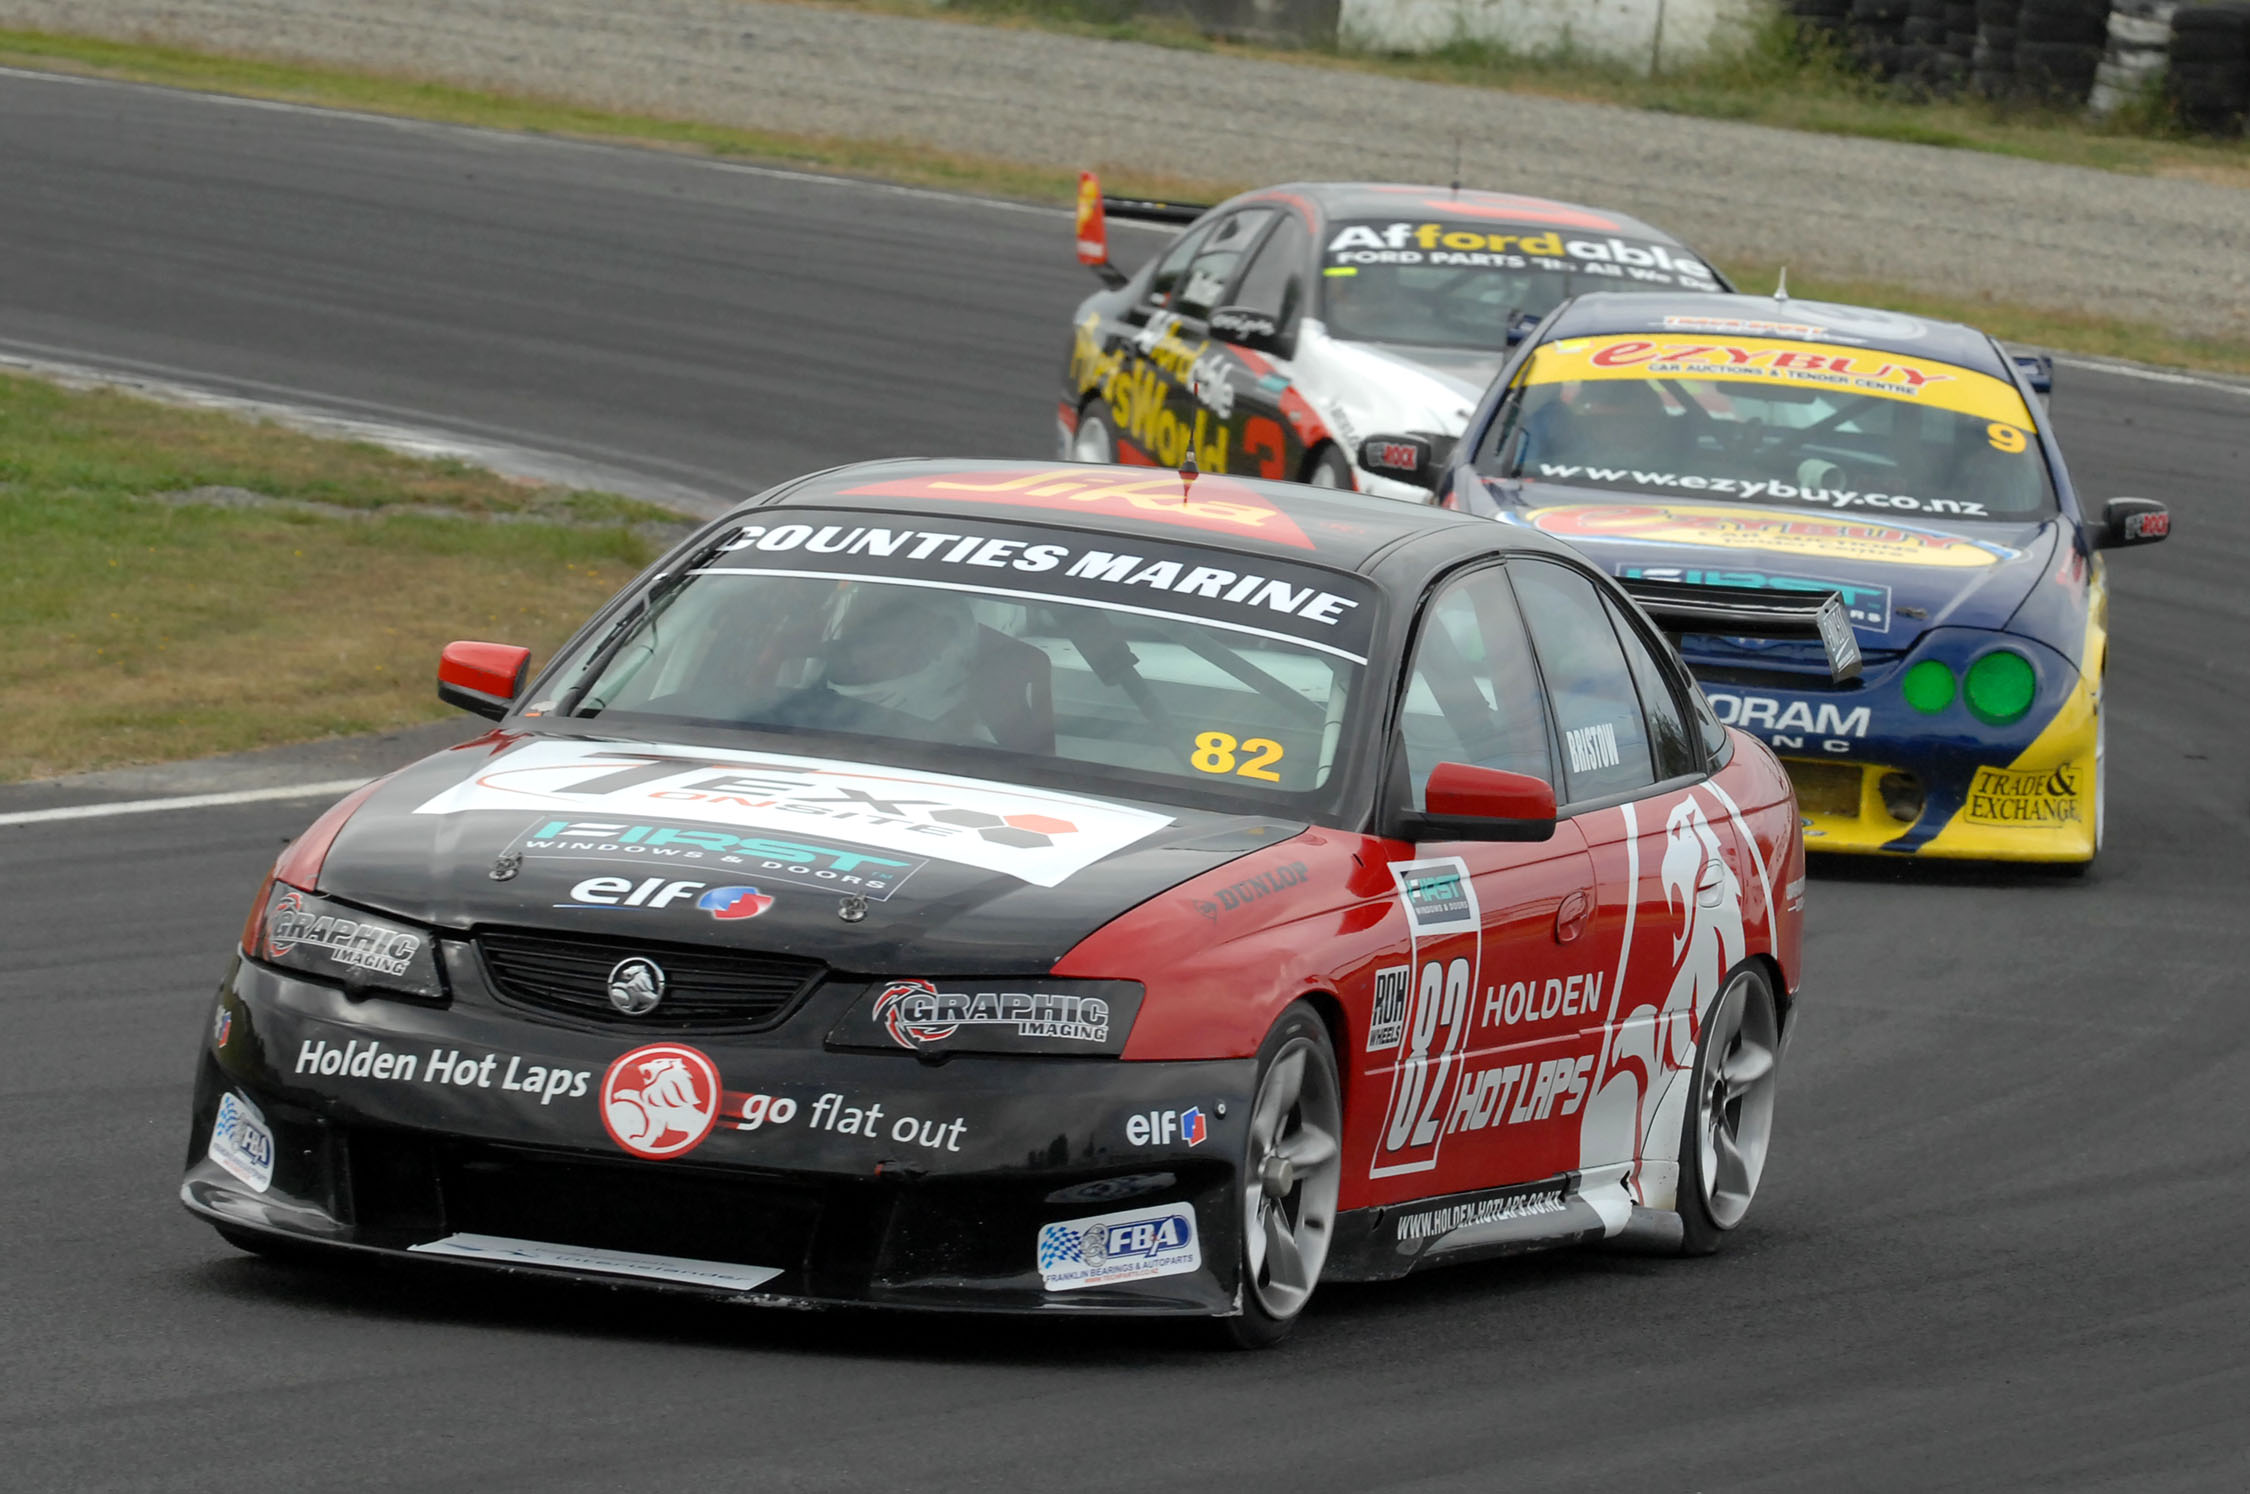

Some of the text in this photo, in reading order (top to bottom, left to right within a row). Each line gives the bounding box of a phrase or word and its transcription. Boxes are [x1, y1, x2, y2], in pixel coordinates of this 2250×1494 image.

[1328, 222, 1713, 281] Affordable
[1337, 250, 1423, 265] FORD
[1430, 251, 1526, 268] PARTS
[1649, 363, 1680, 372] CAR
[1686, 364, 1763, 376] AUCTIONS
[1788, 370, 1849, 385] TENDER
[1855, 378, 1917, 396] CENTRE
[1986, 423, 2027, 454] 9
[1539, 463, 1988, 517] www.ezybuy.co.nz
[720, 523, 1360, 627] COUNTIES MARINE
[1189, 730, 1285, 783] 82
[1565, 722, 1621, 774] BRISTOW
[1978, 771, 2045, 796] TRADE
[648, 790, 973, 838] ONSITE
[1970, 794, 2082, 823] EXCHANGE
[526, 840, 702, 862] WINDOWS
[722, 854, 744, 867] &
[761, 860, 888, 890] DOORS
[533, 820, 912, 872] FIRST
[569, 876, 707, 908] elf
[1213, 861, 1309, 912] DUNLOP
[1405, 873, 1460, 904] FIRST
[270, 911, 422, 963] GRAPHIC
[331, 947, 412, 978] IMAGING
[900, 992, 1110, 1029] GRAPHIC
[1372, 970, 1409, 1027] ROH
[1481, 971, 1605, 1028] HOLDEN
[1018, 1022, 1110, 1043] IMAGING
[1369, 1026, 1402, 1047] WHEELS
[1385, 956, 1471, 1154] 82
[295, 1039, 592, 1106] Holden Hot Laps
[735, 1093, 969, 1152] go flat out
[1126, 1109, 1178, 1146] elf
[1108, 1216, 1179, 1256] FBA
[1396, 1189, 1568, 1241] WWW.HOLDEN-HOTLAPS.CO.NZ
[1046, 1269, 1089, 1283] FRANKLIN
[1090, 1262, 1134, 1277] BEARINGS
[1143, 1253, 1194, 1269] AUTOPARTS
